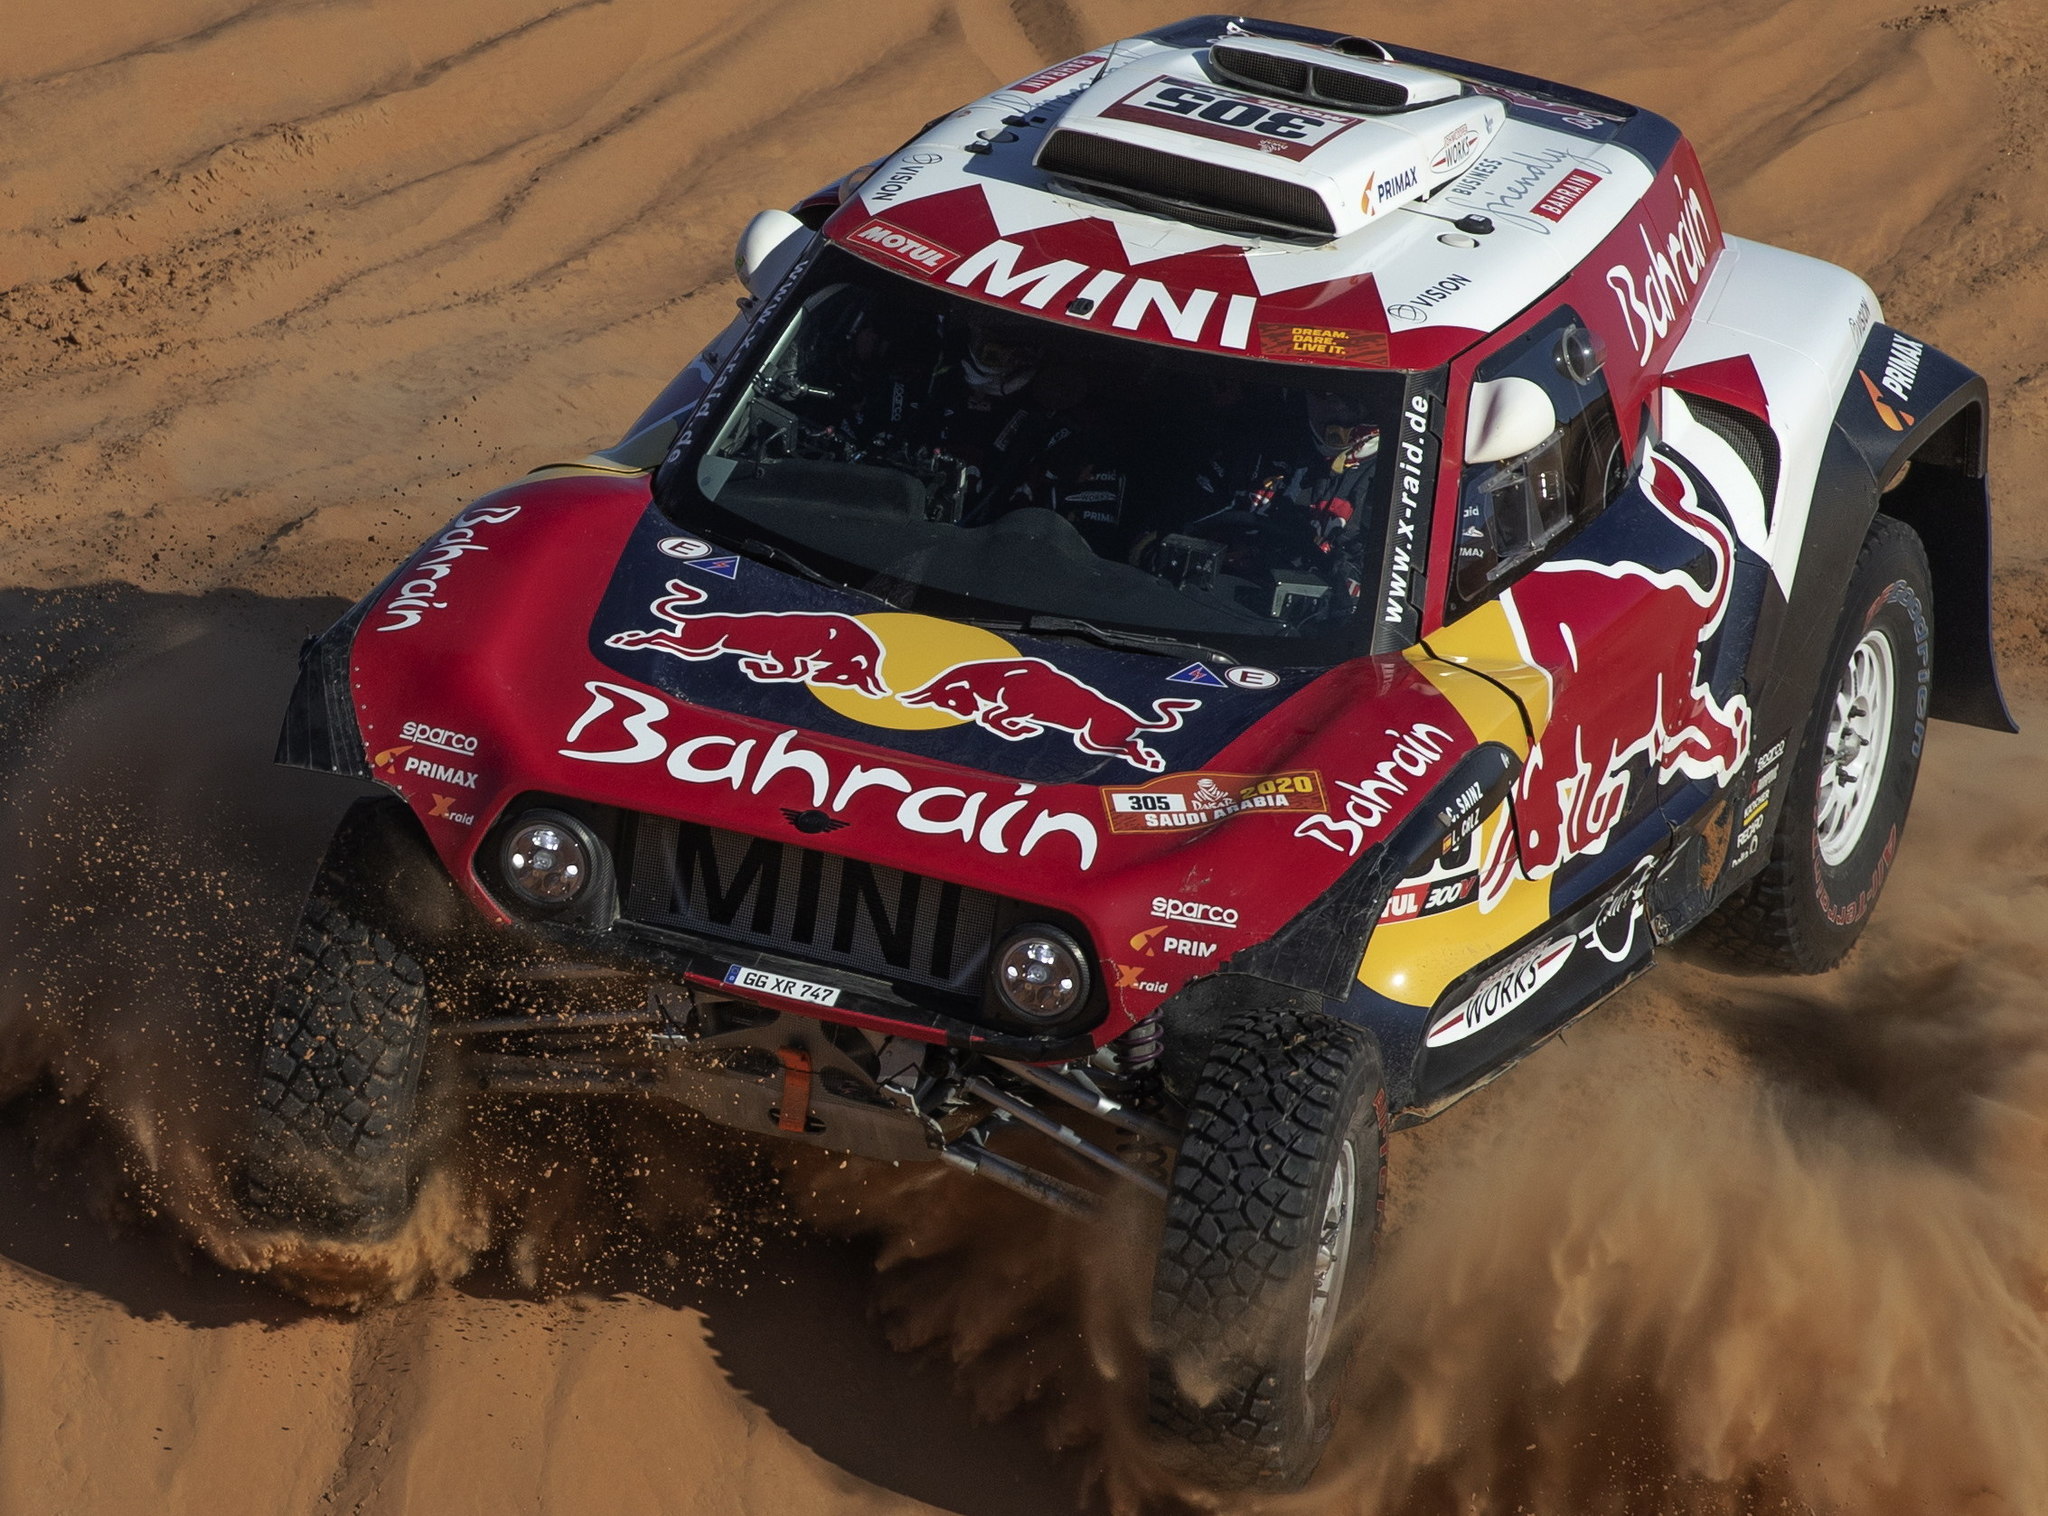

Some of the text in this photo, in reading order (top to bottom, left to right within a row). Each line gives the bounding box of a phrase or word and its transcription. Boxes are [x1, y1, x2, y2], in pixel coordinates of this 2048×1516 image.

[1143, 87, 1325, 140] 305
[1444, 137, 1470, 168] WORKS
[871, 164, 924, 202] VISION
[1377, 165, 1419, 204] PRIMAX
[1452, 157, 1503, 196] BUSINESS
[1540, 174, 1595, 216] BAHRAIN
[857, 225, 946, 268] MOTUL
[1606, 173, 1712, 368] Bahrain
[946, 238, 1258, 350] MINI
[1409, 273, 1473, 308] VISION
[1291, 327, 1351, 340] DREAM.
[1292, 335, 1338, 346] DARE.
[1293, 343, 1348, 355] LIVE IT.
[1881, 333, 1924, 402] PRIMAX
[1384, 394, 1429, 624] www.x-raid.de
[376, 504, 522, 632] Bahrain
[399, 721, 479, 757] sparco
[404, 756, 479, 790] PRIMAX
[557, 680, 1098, 871] Bahrain
[1239, 775, 1314, 800] 2020
[1293, 722, 1455, 857] Bahrain
[1127, 795, 1171, 811] 305
[1144, 794, 1290, 828] SAUDI ARABIA
[1455, 780, 1484, 816] SAINZ
[669, 817, 961, 980] MINI
[1424, 875, 1478, 910] 300V
[1151, 895, 1239, 929] sparco
[743, 972, 834, 1002] GG XR 747
[1114, 964, 1169, 994] X-raid
[1466, 954, 1542, 1029] WORKS
